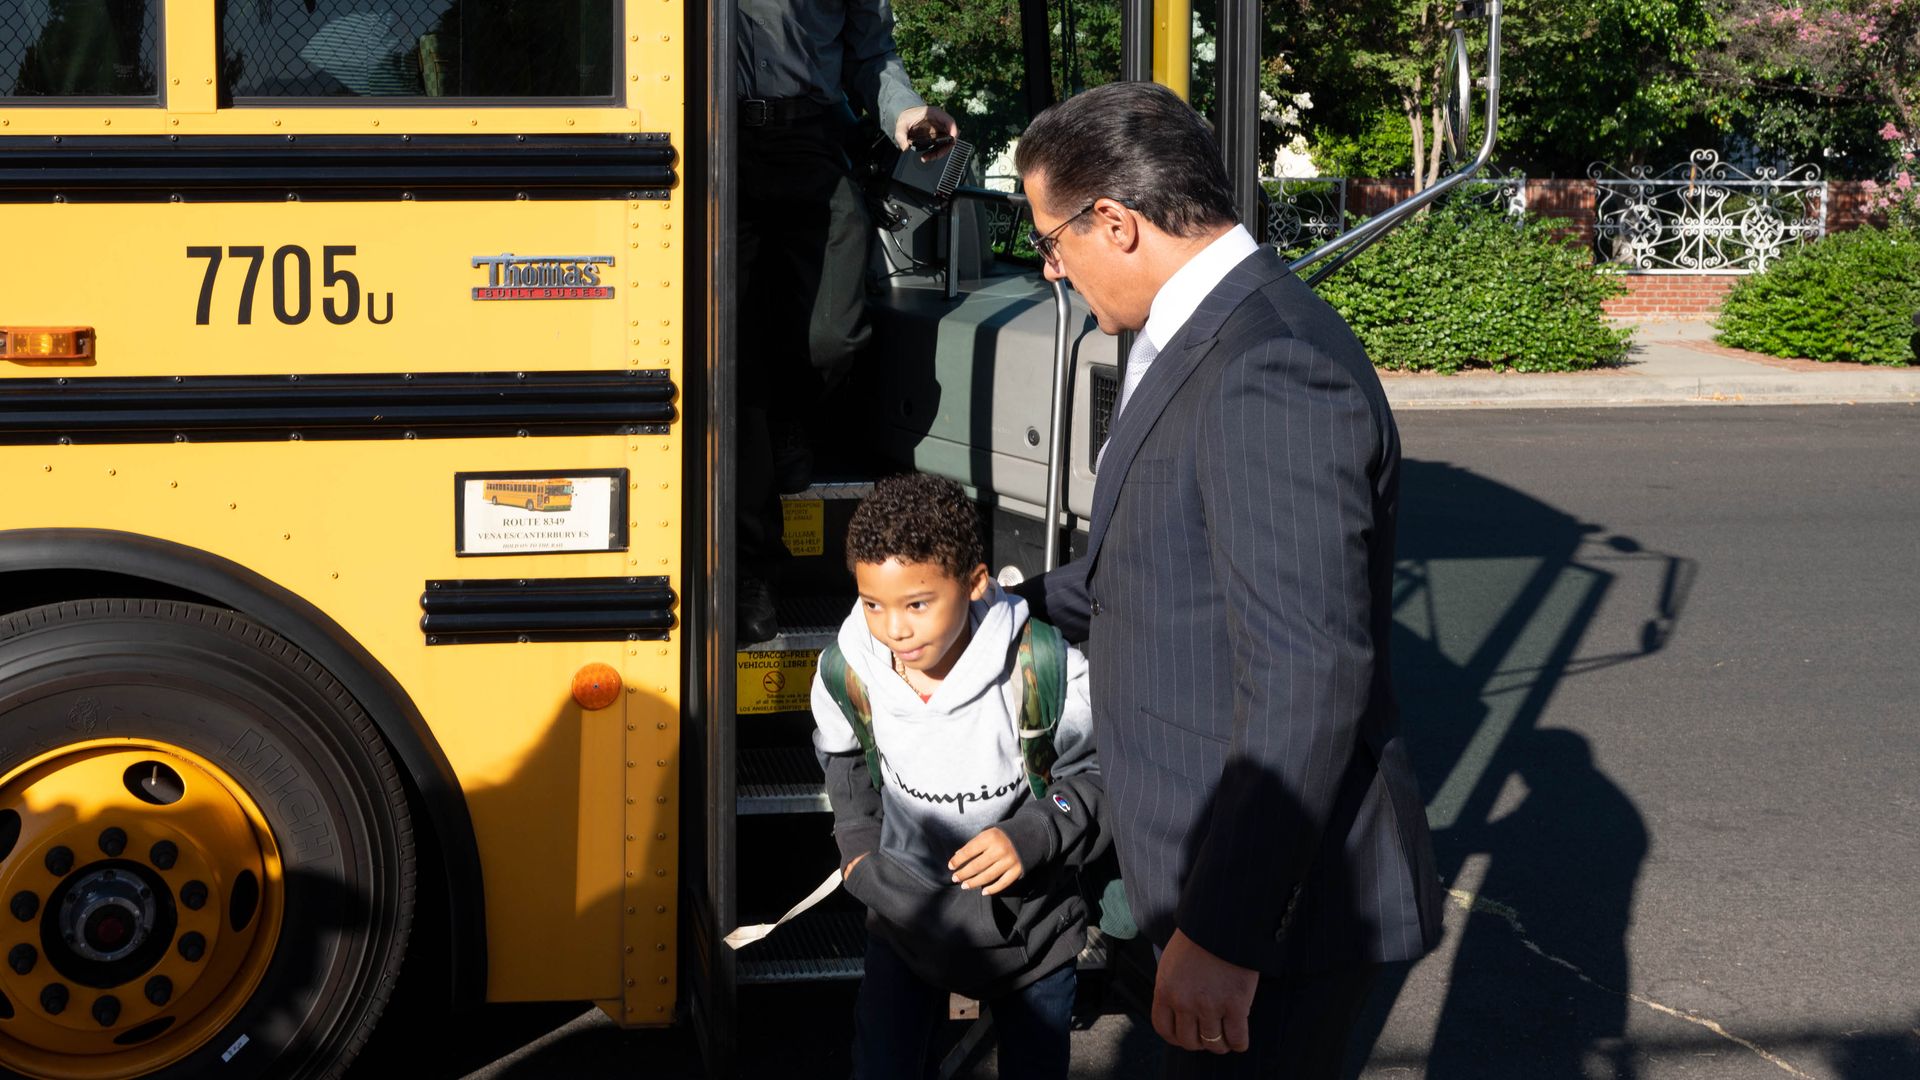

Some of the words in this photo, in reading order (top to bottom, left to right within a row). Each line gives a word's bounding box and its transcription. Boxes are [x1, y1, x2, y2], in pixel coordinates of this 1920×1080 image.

[471, 252, 616, 288] Thomas
[484, 288, 534, 298] BUILT
[543, 288, 604, 298] BUSES
[503, 517, 540, 527] ROUTE
[543, 517, 565, 526] 8349
[478, 532, 501, 540] VENA
[578, 530, 590, 538] ES
[747, 650, 810, 660] TOBACCO-FREE
[783, 660, 807, 668] LIBRE
